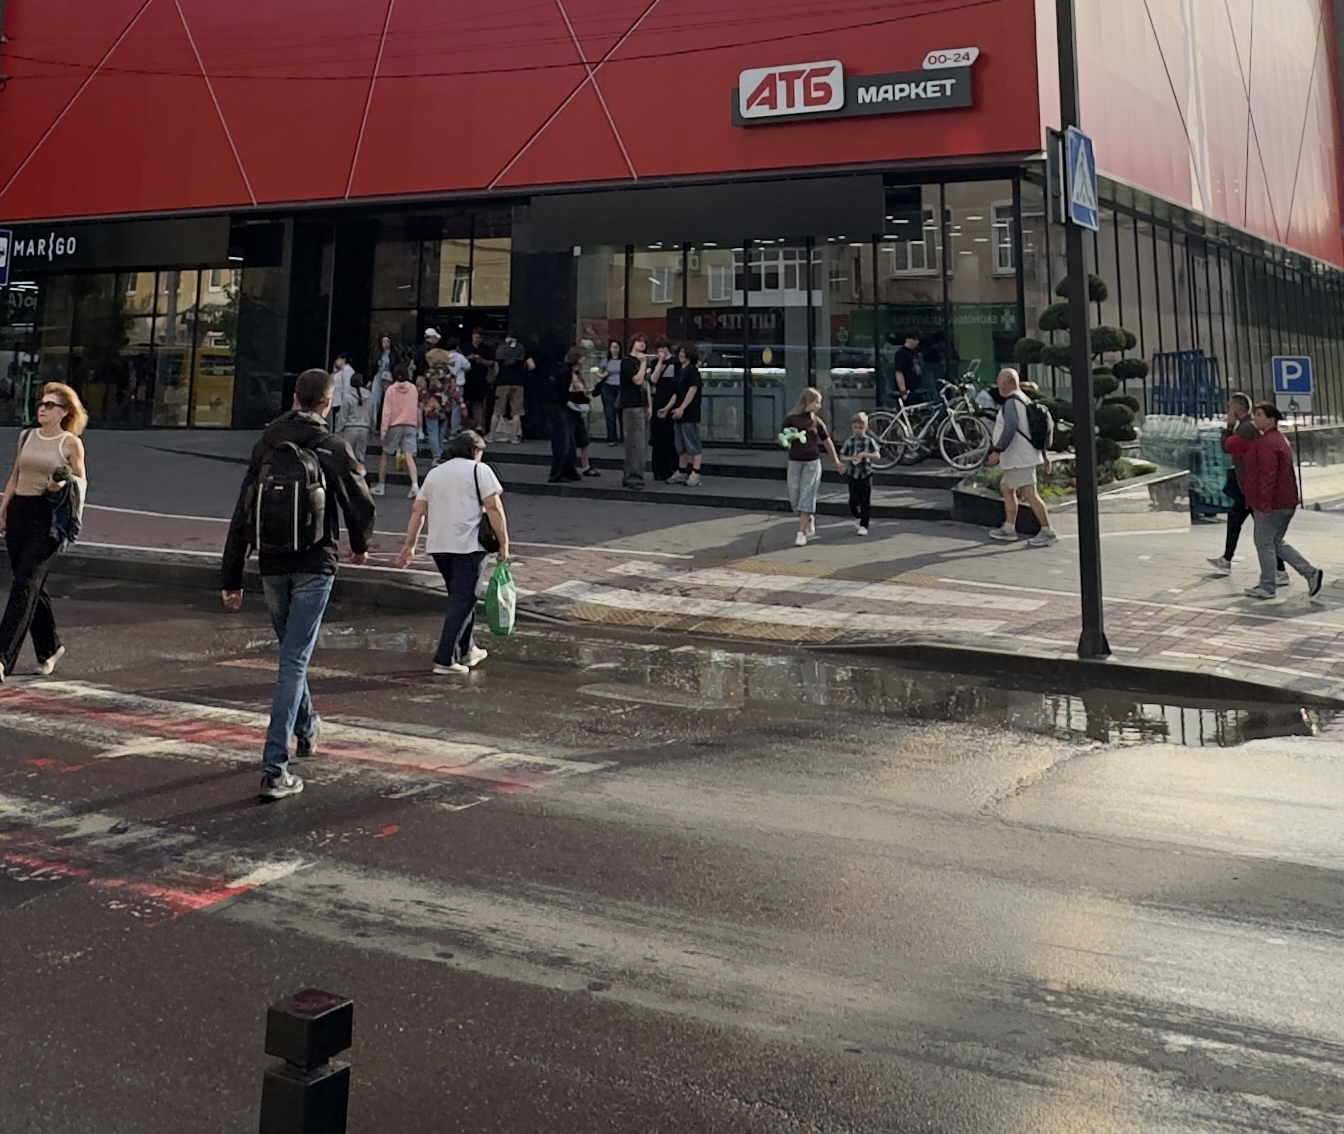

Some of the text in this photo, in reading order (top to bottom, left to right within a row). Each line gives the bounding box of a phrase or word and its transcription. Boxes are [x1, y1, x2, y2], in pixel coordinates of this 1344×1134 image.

[927, 51, 971, 65] 00-24
[746, 66, 957, 111] АТБ МАРКЕТ
[1281, 360, 1303, 389] P
